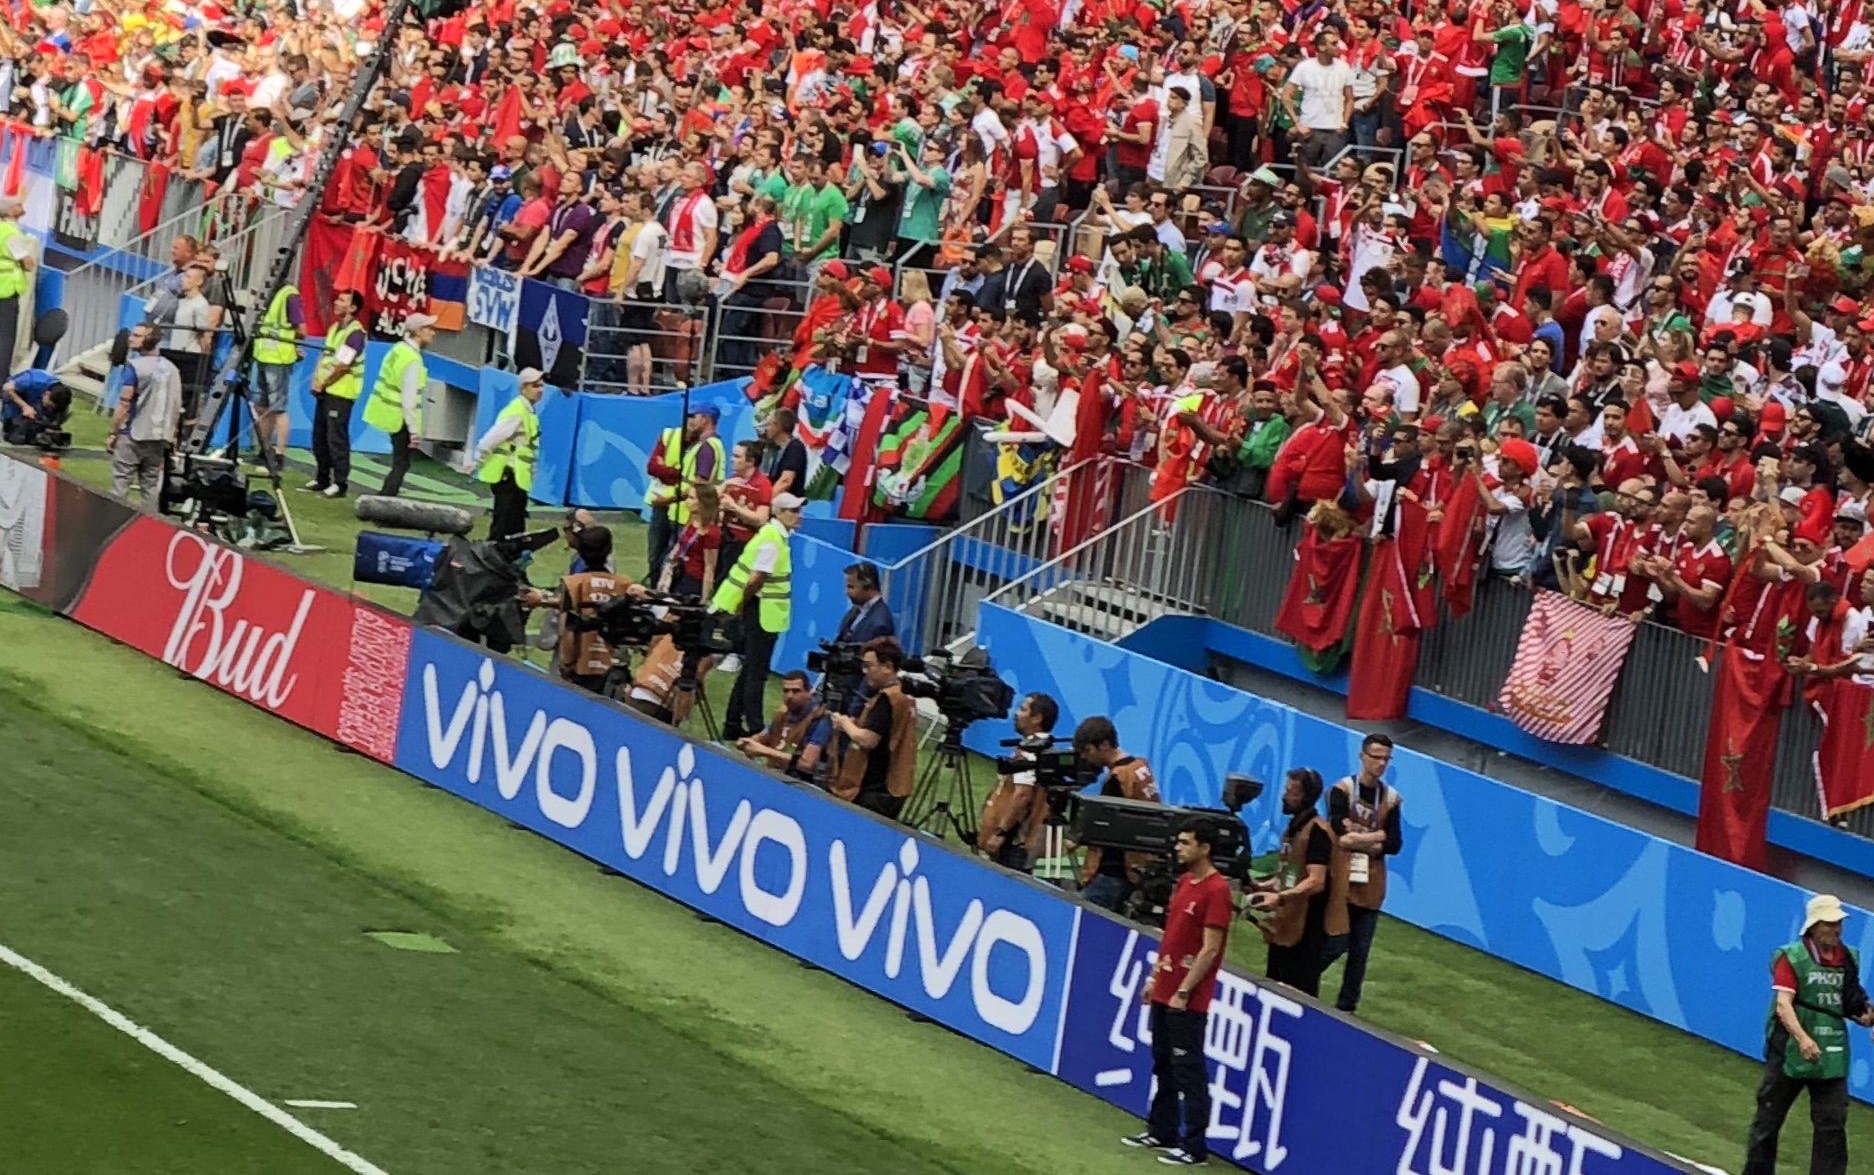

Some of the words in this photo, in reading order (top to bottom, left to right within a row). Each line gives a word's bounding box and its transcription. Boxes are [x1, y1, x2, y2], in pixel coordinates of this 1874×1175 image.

[163, 530, 316, 708] Bud
[423, 657, 597, 829] vivo
[617, 743, 808, 927] vivo
[829, 837, 1047, 1036] vivo
